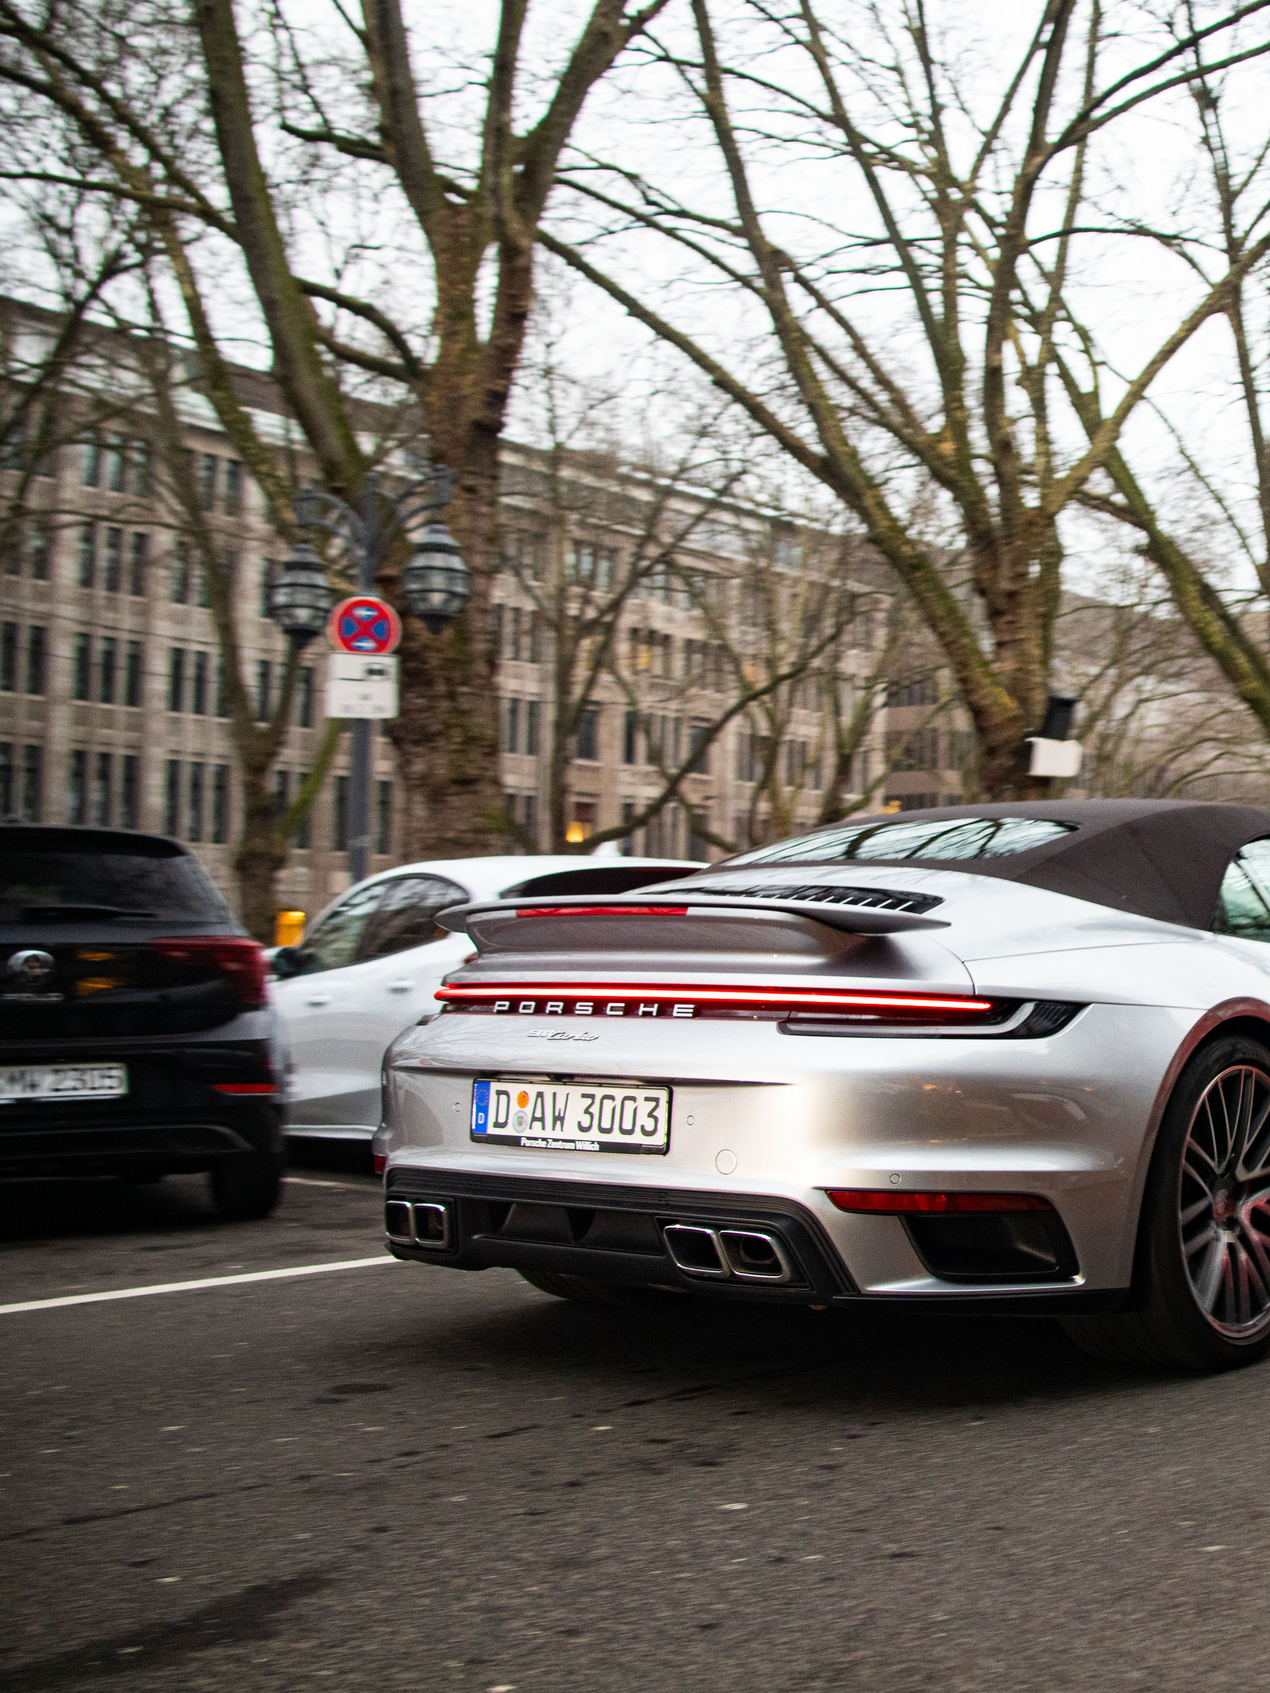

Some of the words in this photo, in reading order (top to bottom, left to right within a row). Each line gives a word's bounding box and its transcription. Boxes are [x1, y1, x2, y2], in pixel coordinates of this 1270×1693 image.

[493, 1001, 695, 1018] PORSCHE
[477, 1112, 486, 1124] D
[492, 1089, 511, 1129] D
[529, 1091, 570, 1132] AW
[577, 1093, 661, 1137] 3003
[520, 1136, 547, 1148] Porsche
[546, 1138, 576, 1150] Zentrum
